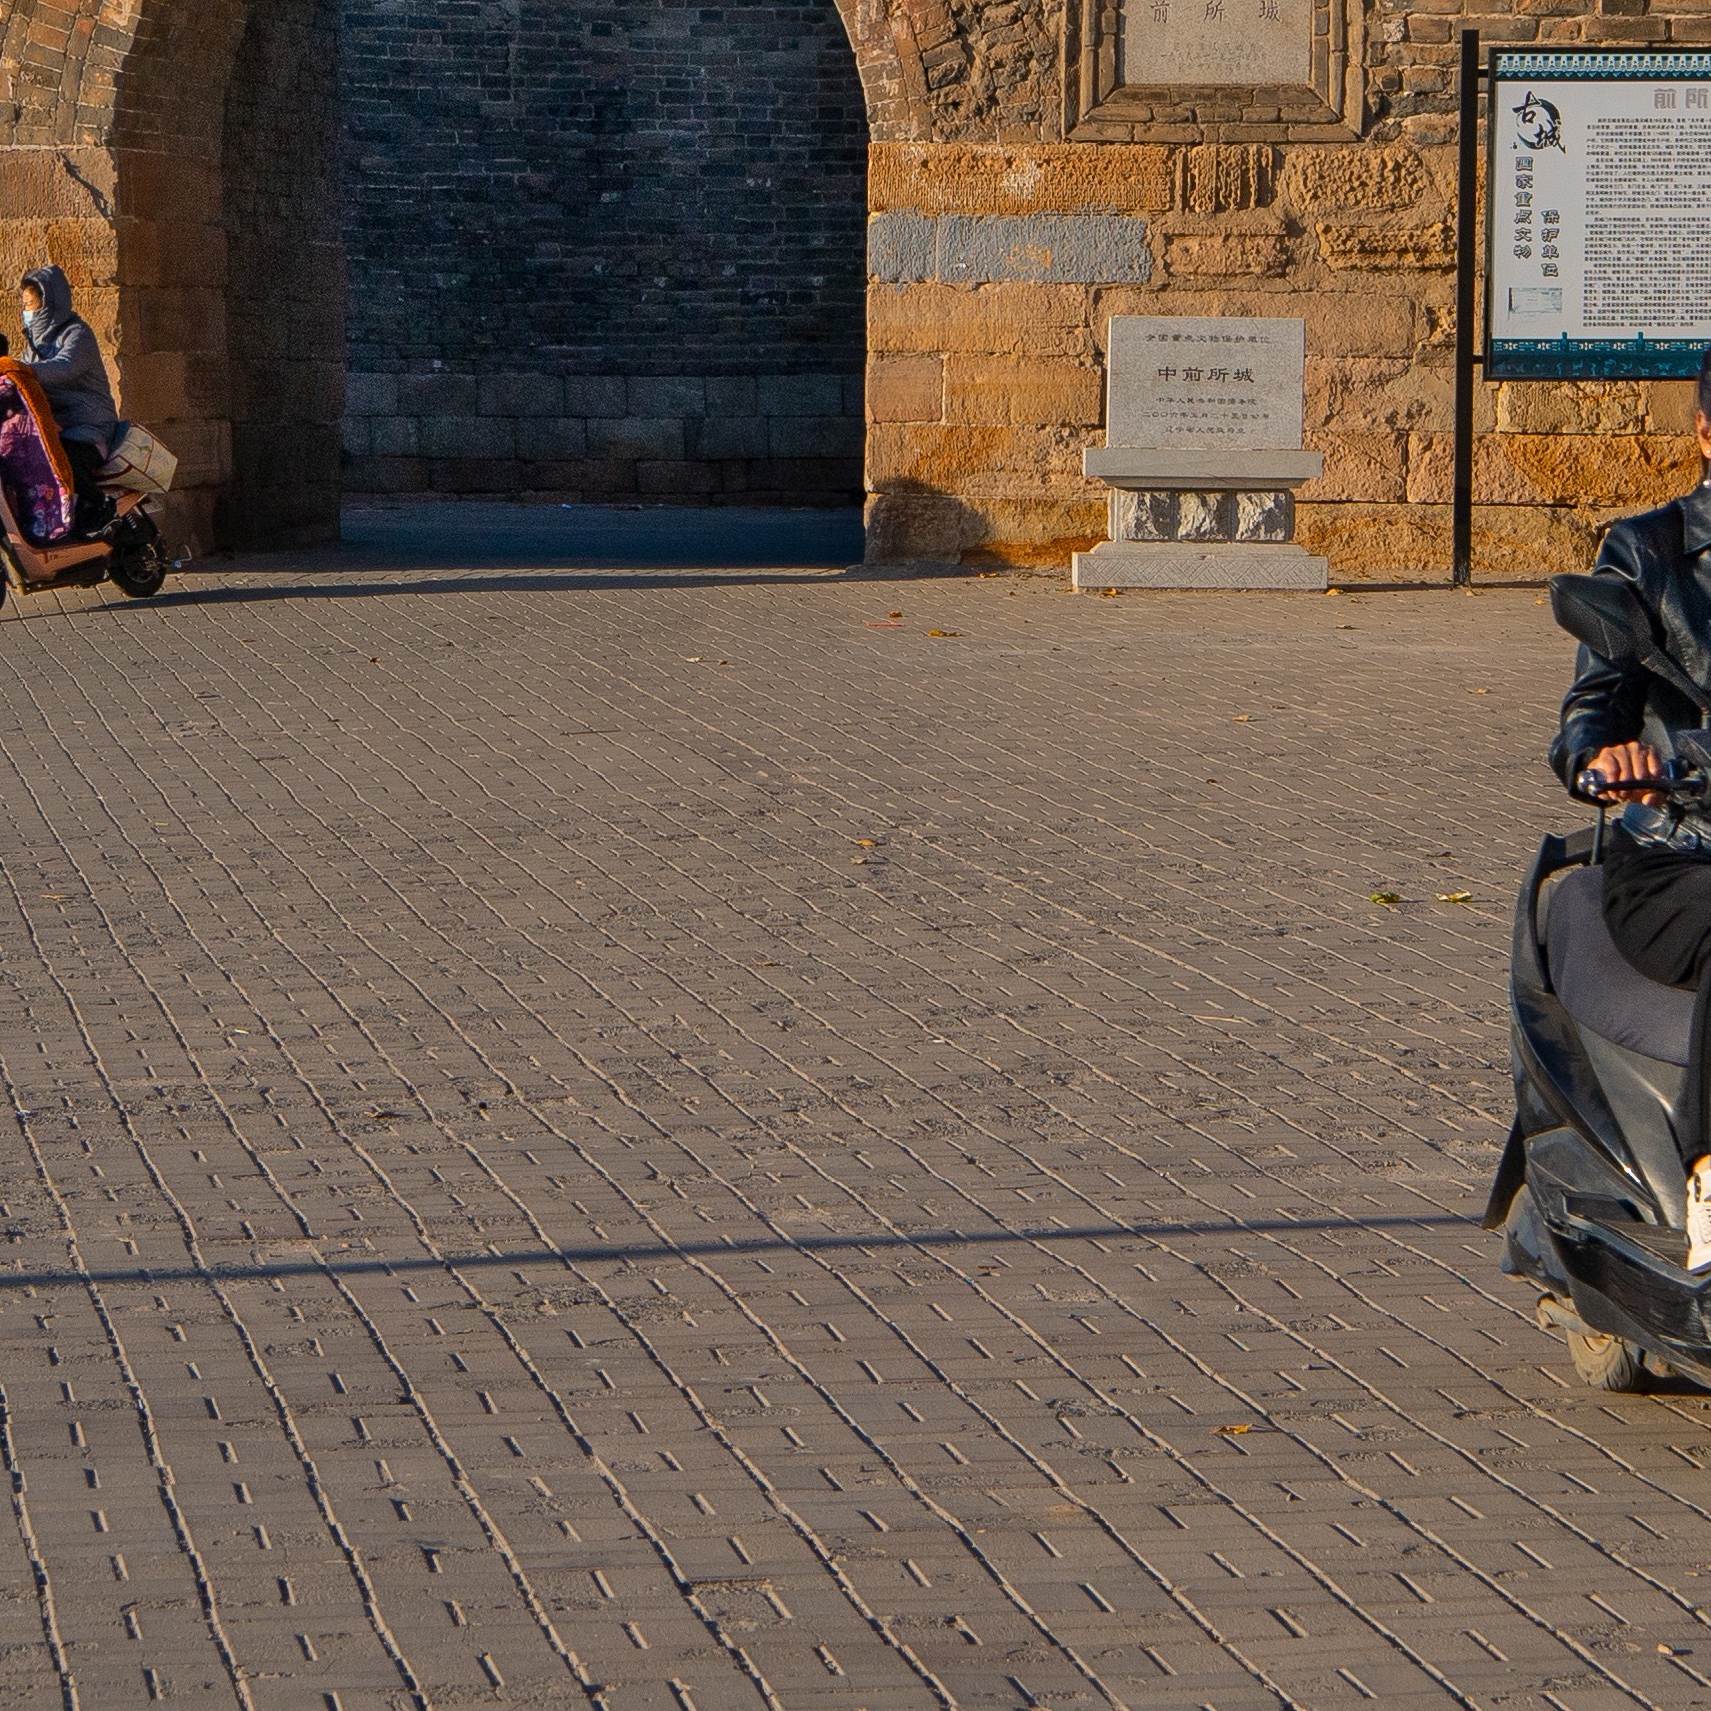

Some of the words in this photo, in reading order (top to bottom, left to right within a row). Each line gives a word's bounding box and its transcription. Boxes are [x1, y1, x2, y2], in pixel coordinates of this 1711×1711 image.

[1512, 90, 1567, 154] 古城
[1513, 156, 1534, 259] 国家重点文物
[1540, 208, 1561, 278] 保护单位
[1157, 365, 1256, 384] 中前所城
